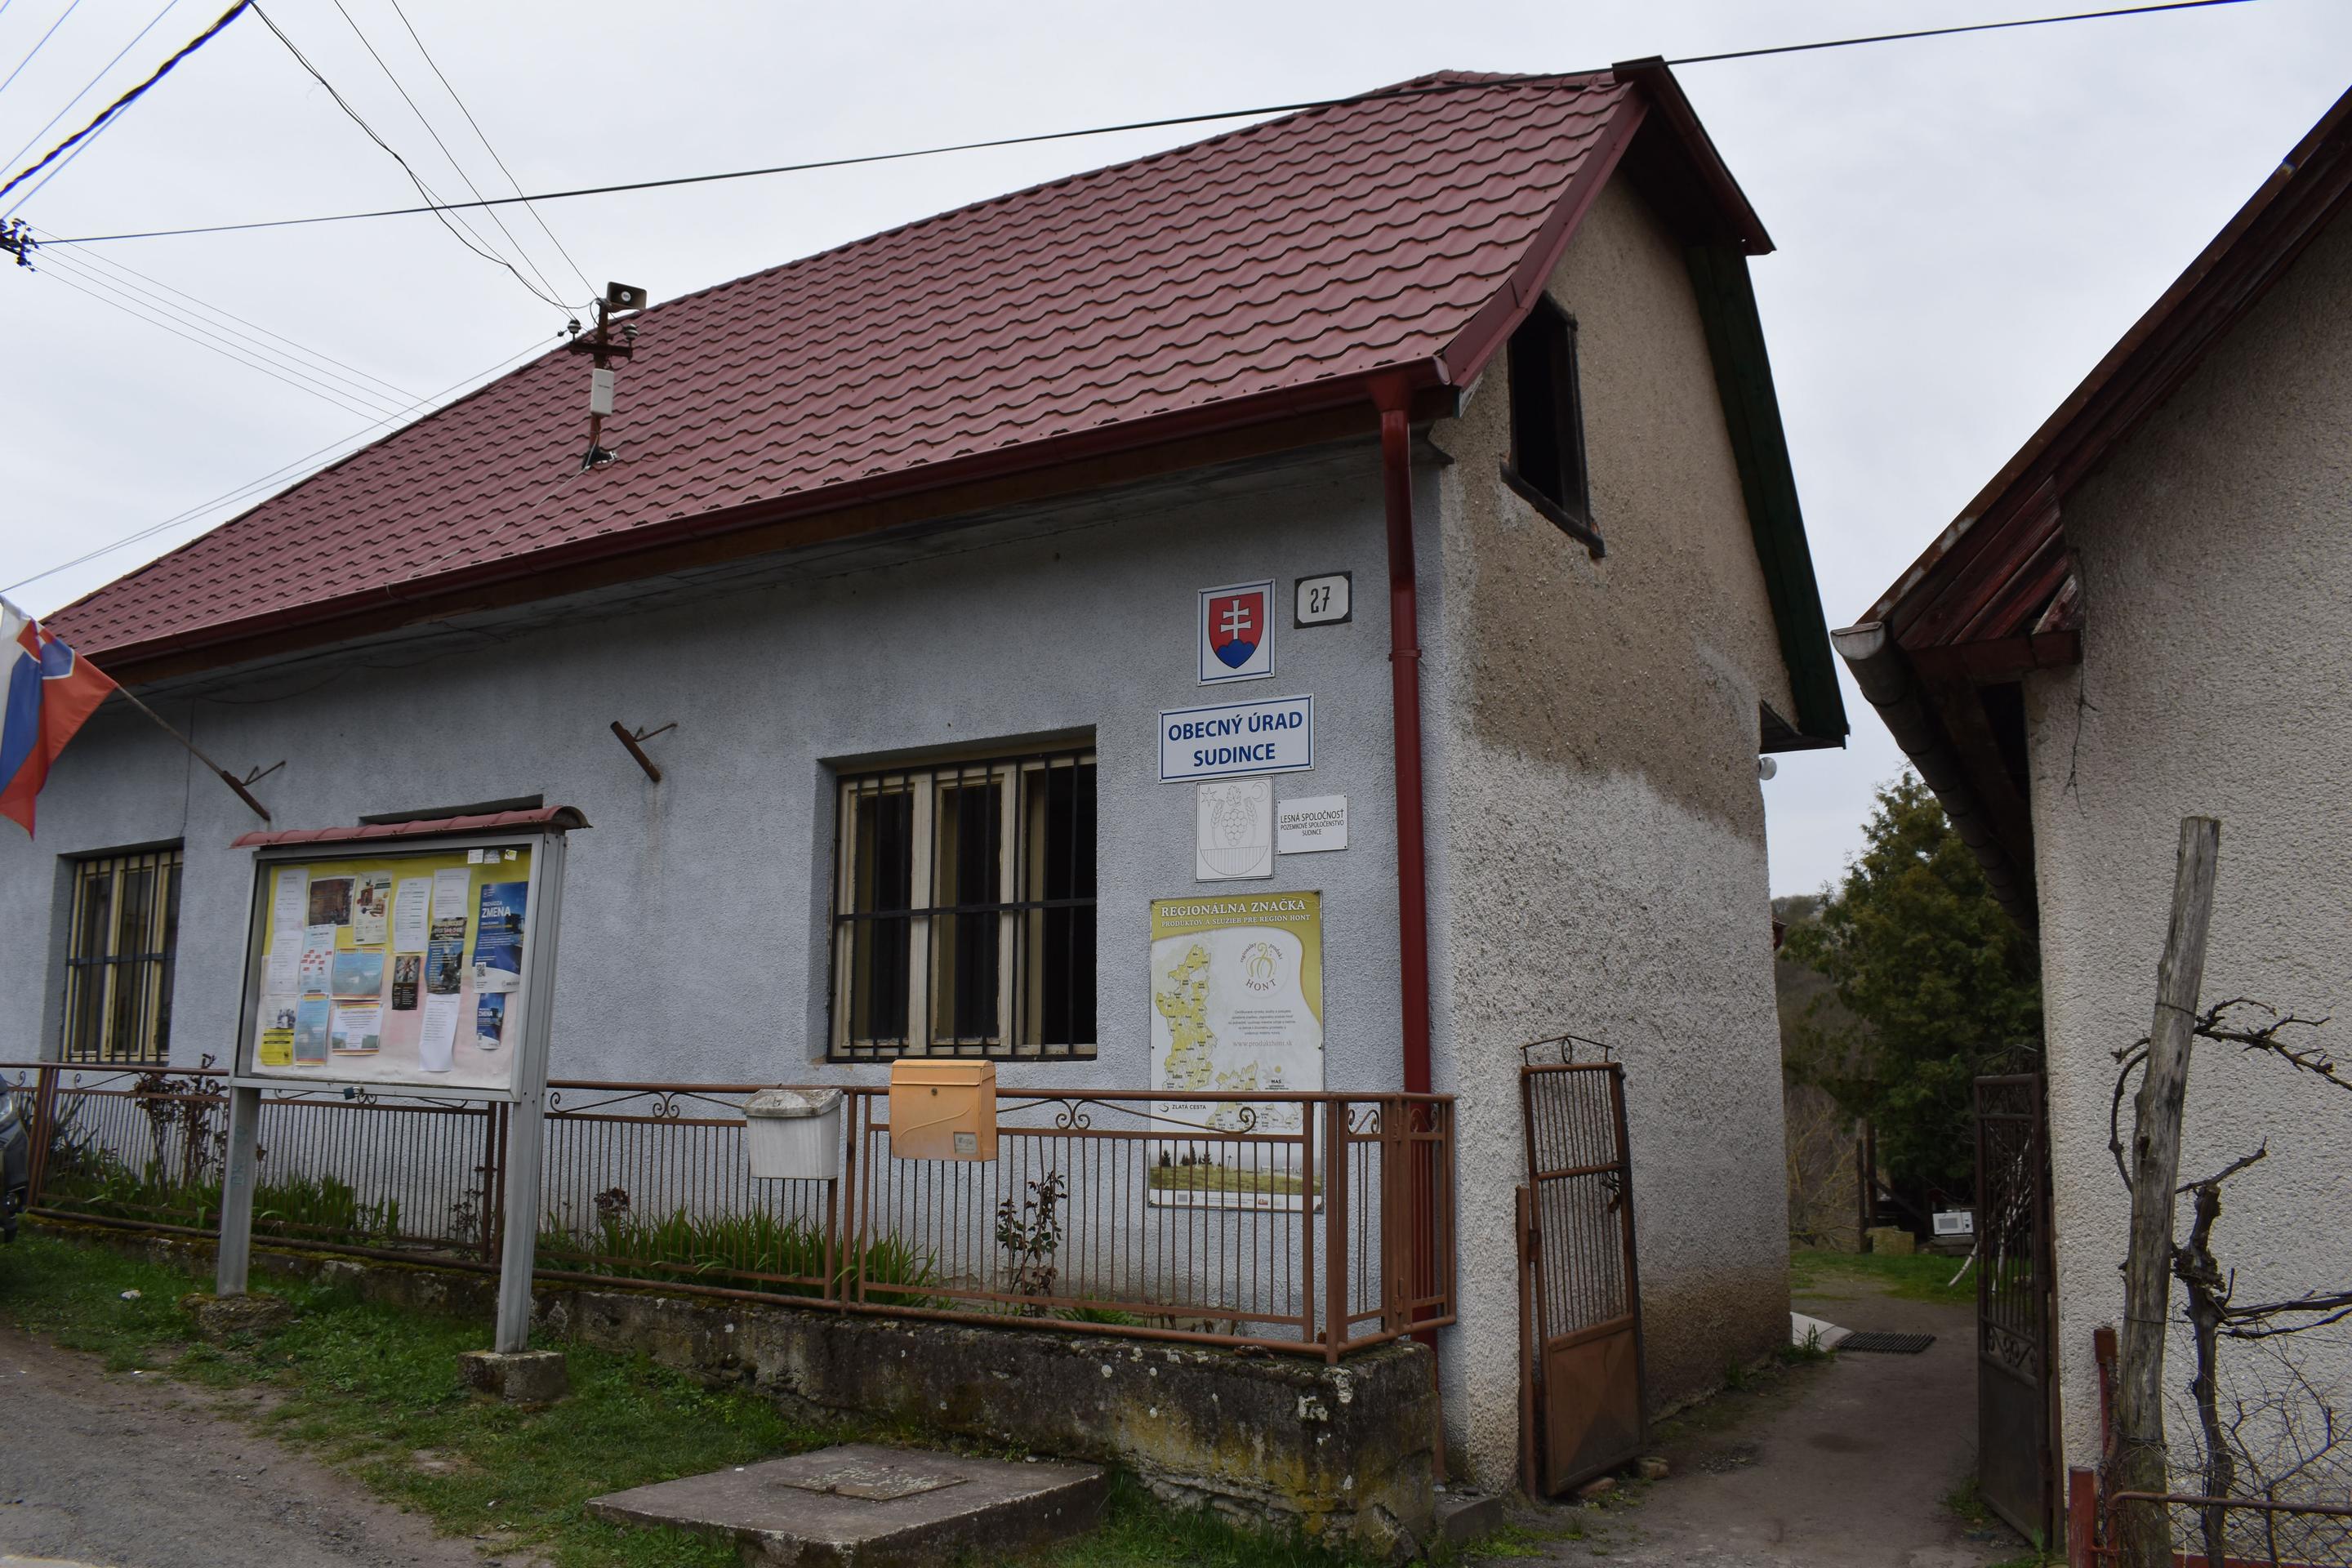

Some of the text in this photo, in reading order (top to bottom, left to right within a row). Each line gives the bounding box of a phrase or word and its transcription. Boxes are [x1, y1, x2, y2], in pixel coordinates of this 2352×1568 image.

[1310, 586, 1330, 613] 27
[1168, 711, 1303, 742] OBECNÝ ÚRAD
[1193, 742, 1276, 767] SUDINCE
[1281, 808, 1344, 823] LESNÁ SPOLOČNOSŤ
[1308, 819, 1344, 829] SPOLOČENSTVO
[481, 906, 511, 919] ZMENA
[1161, 898, 1306, 917] REGIONÁLNA ZNAČKA
[1245, 978, 1276, 991] HONT
